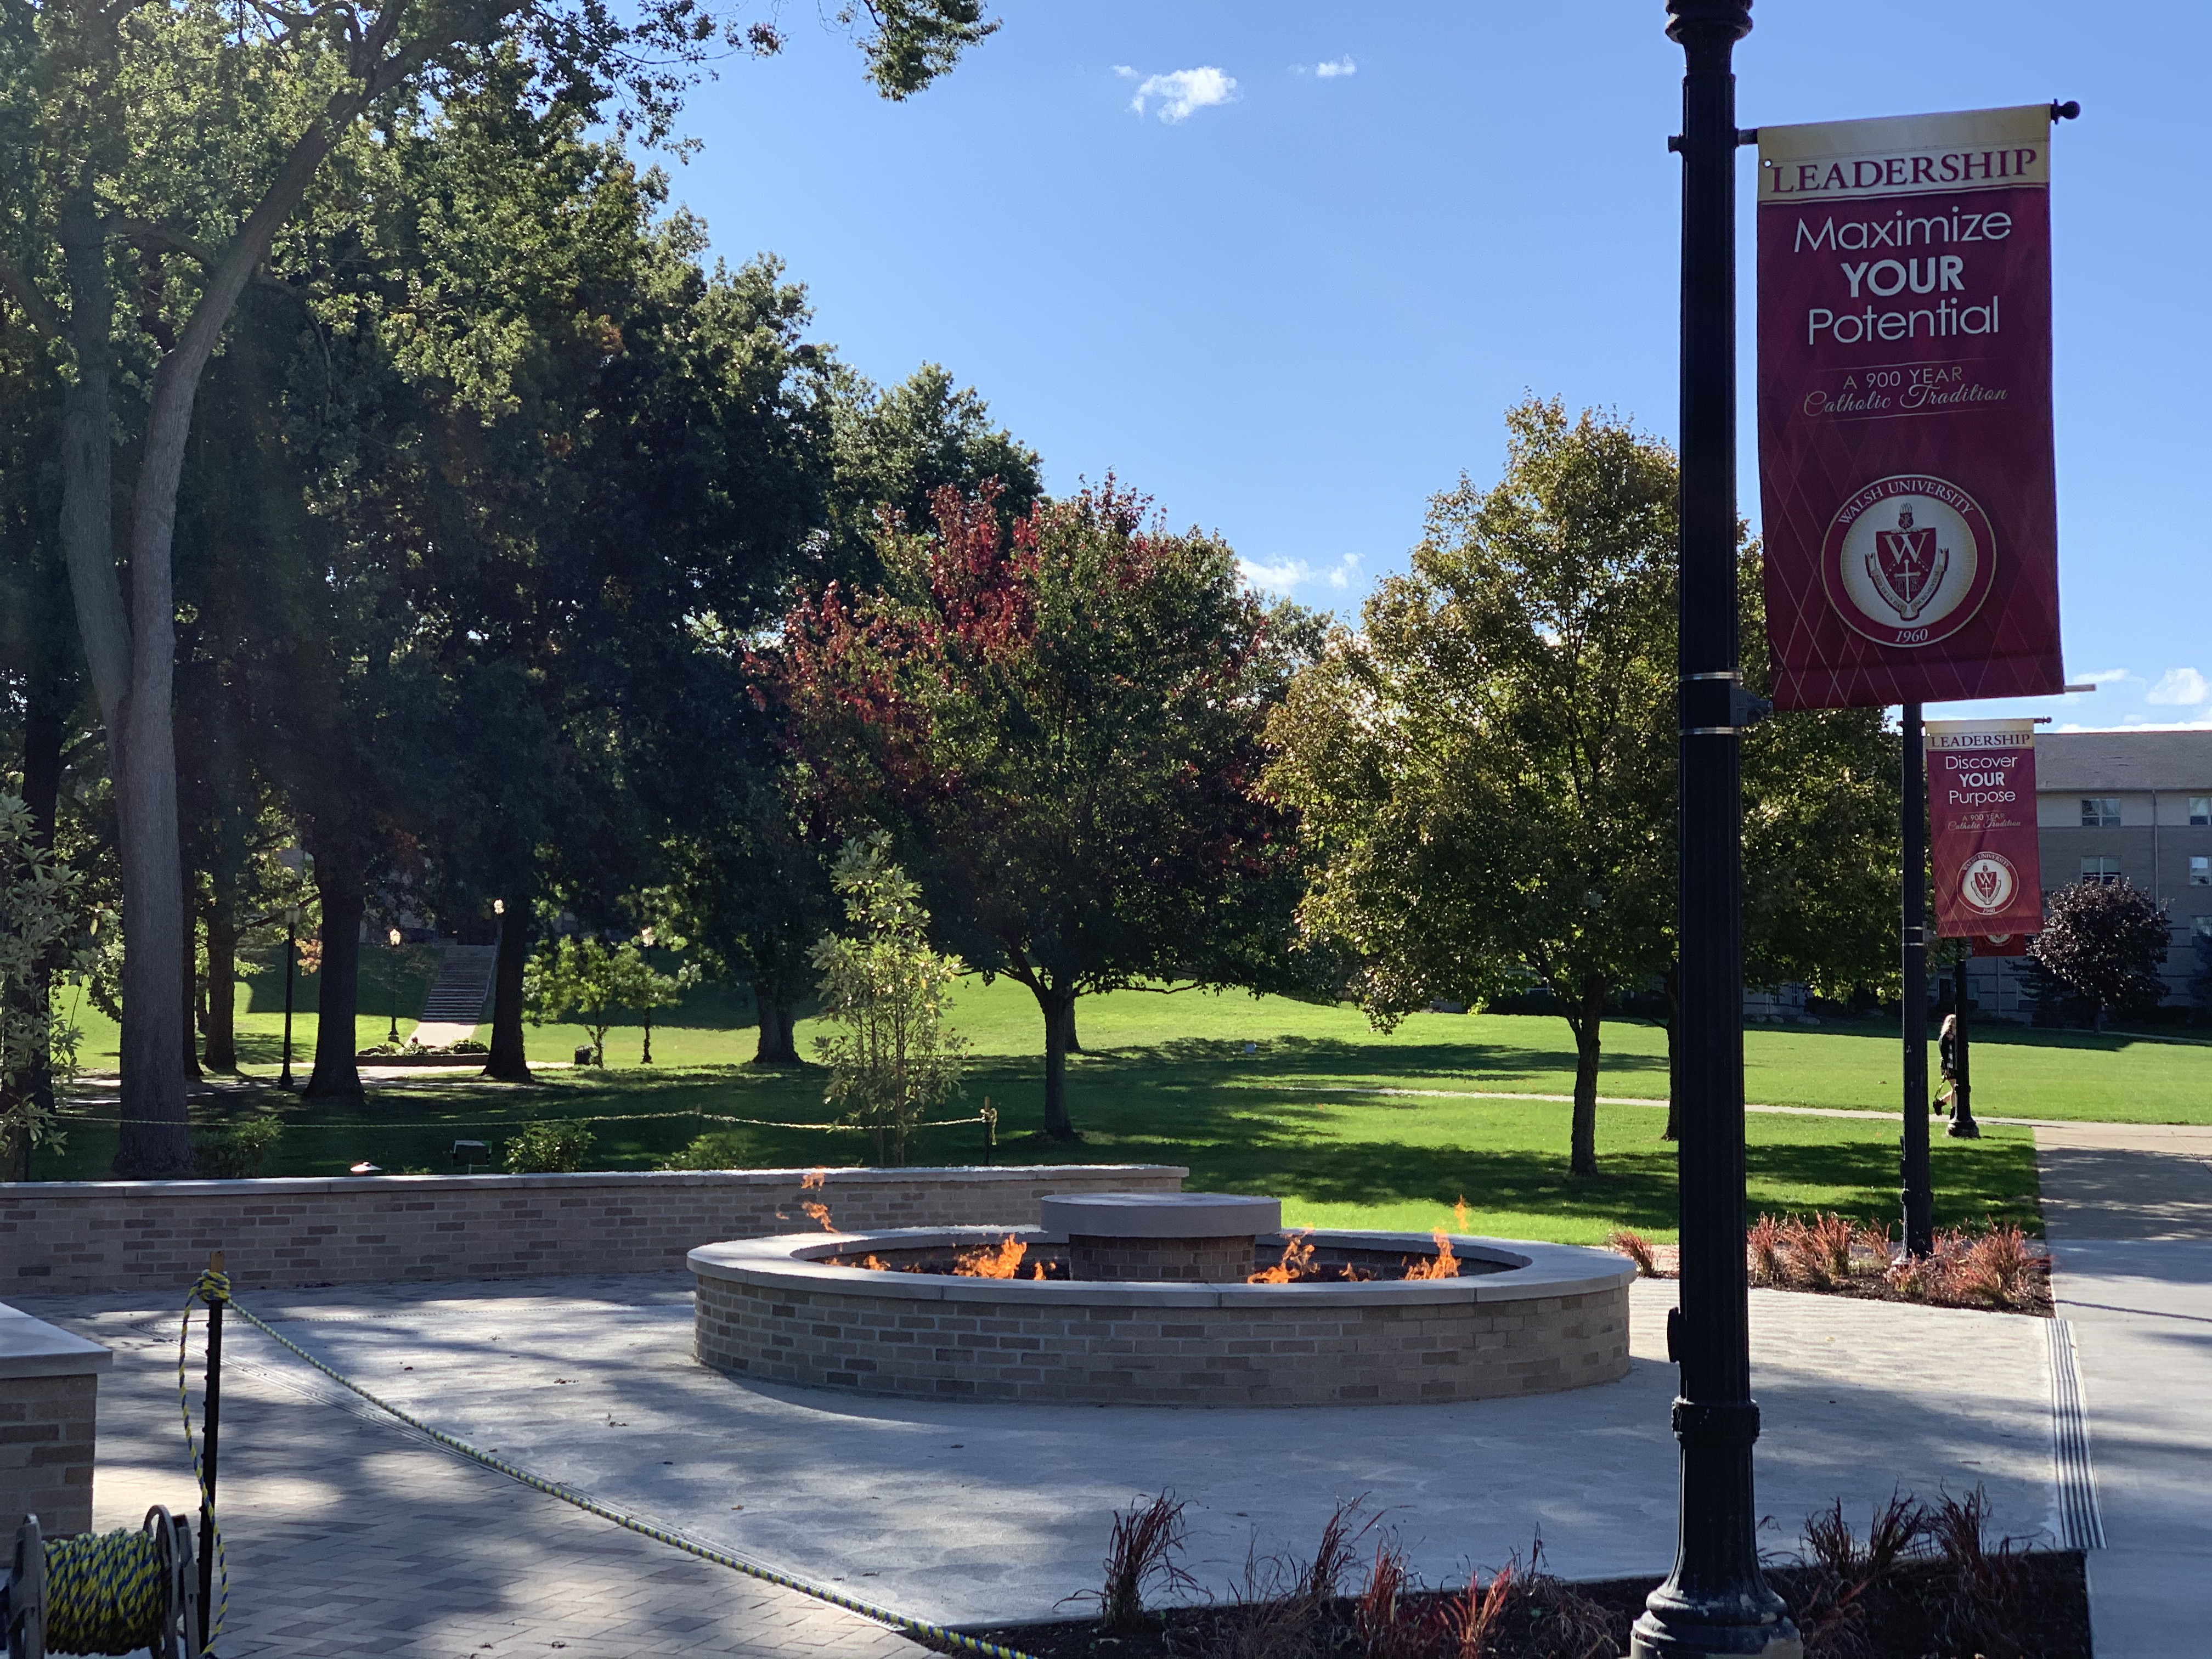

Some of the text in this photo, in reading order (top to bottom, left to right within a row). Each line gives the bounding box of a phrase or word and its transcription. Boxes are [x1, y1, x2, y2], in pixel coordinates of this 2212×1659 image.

[1771, 148, 2037, 193] LEADERSHIP
[1793, 205, 2013, 253] Maximize
[1841, 255, 1966, 298] YOUR
[1808, 295, 1999, 346] Potential
[1843, 366, 1962, 390] A 900 YEAR
[1803, 383, 2008, 417] Catholic Tradition
[1838, 480, 1974, 524] WALSH UNIVERSITY
[1883, 532, 1930, 565] W
[1895, 628, 1929, 644] 1960
[1931, 733, 2030, 747] LEADERSHIP
[1945, 755, 2018, 770] Discover
[1959, 771, 2005, 787] YOUR
[1949, 790, 2016, 806] Purpose
[1948, 819, 2021, 831] Catholic Tradition
[1978, 853, 2010, 867] UNIVERSITY
[1977, 873, 1994, 885] W
